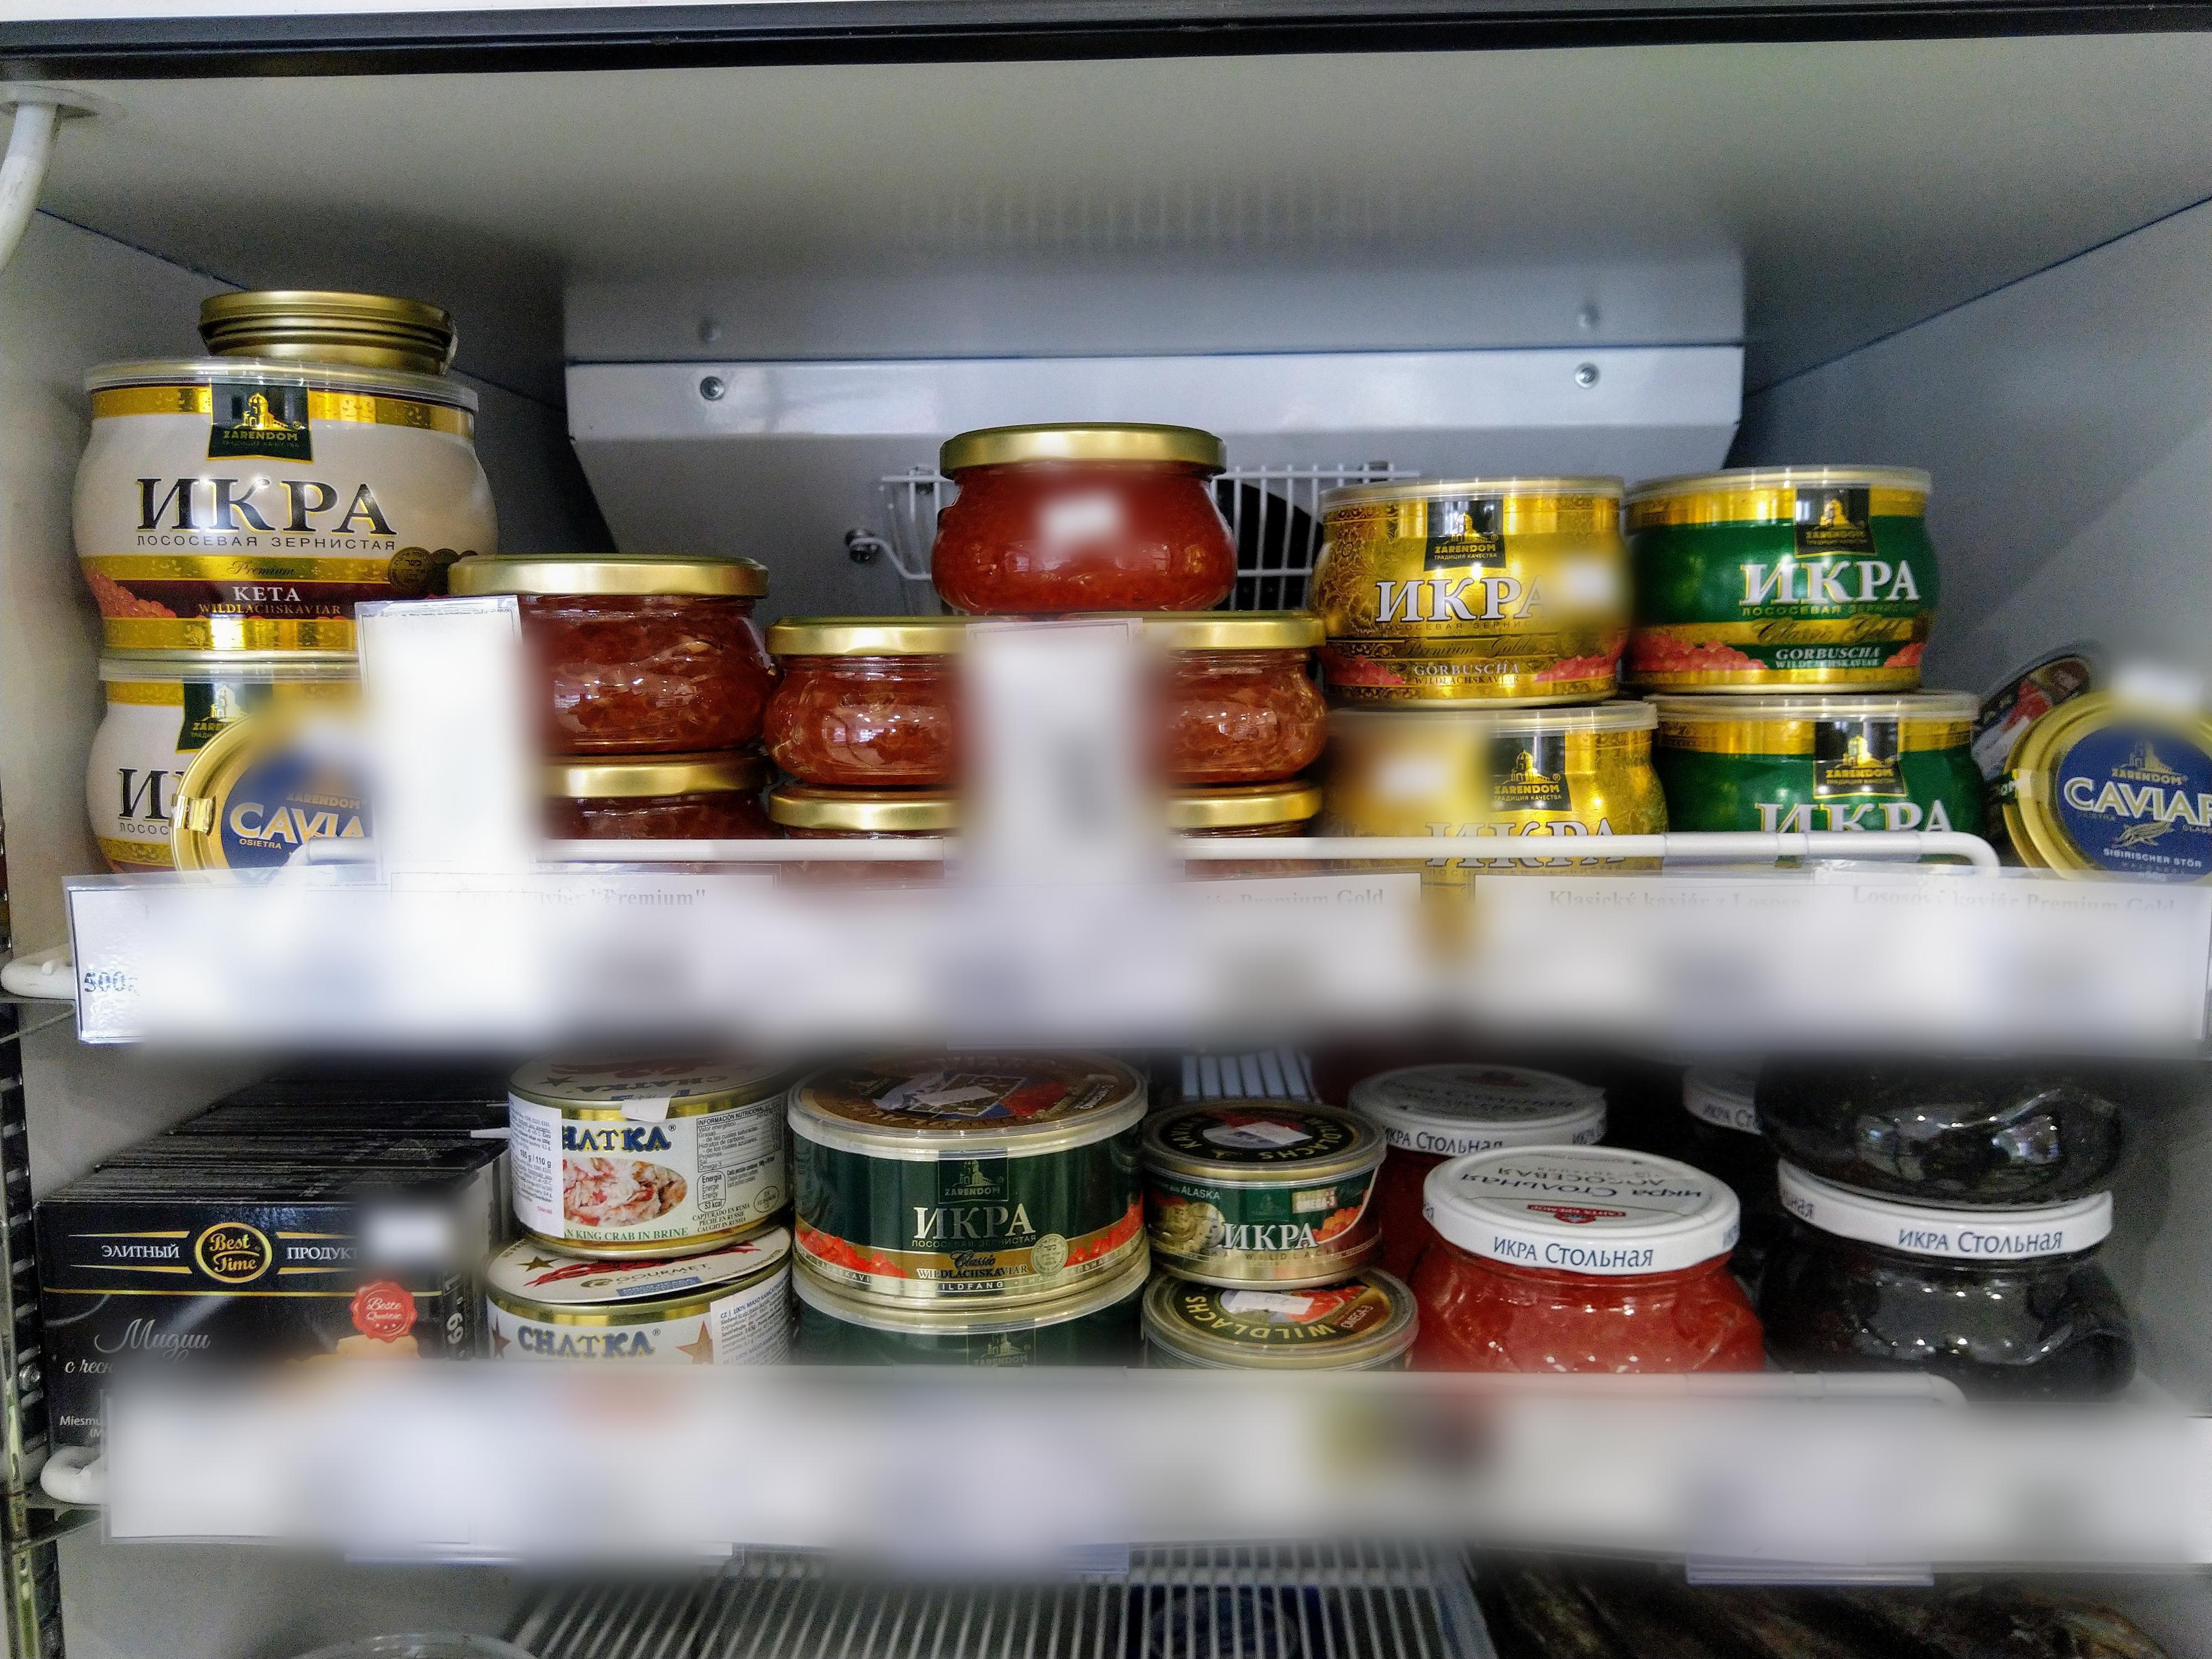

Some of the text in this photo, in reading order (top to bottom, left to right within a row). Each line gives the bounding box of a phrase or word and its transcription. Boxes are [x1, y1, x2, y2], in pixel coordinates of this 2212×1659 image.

[223, 430, 298, 441] ZARENDOM
[138, 478, 397, 536] ИКРА
[137, 535, 395, 551] ЛОСОСЕВАЯ ЗЕРНИСТАЯ
[1434, 544, 1496, 554] ZARENDOM
[227, 560, 295, 576] Premium
[1739, 560, 1921, 605] ИКРА
[1776, 646, 1880, 660] GORBUSCHA
[1414, 664, 1519, 676] GORBUSCHA
[1494, 785, 1559, 795] ZARENDOM
[239, 838, 281, 849] OSIETRA
[535, 1155, 545, 1165] 110
[1181, 1186, 1220, 1200] ALASKA
[692, 1210, 727, 1221] CAPTURADO
[913, 1203, 1036, 1240] ИКРА
[576, 1230, 601, 1240] KING
[605, 1232, 635, 1240] CRAB
[654, 1227, 688, 1239] BRINE
[697, 1224, 721, 1233] CAUGHT
[1222, 1222, 1318, 1251] ИКРА
[209, 1233, 250, 1253] Best
[1898, 1229, 1949, 1251] ИКРА
[101, 1242, 180, 1260] ЭЛИТНЫЙ
[1494, 1237, 1537, 1261] ИКРА
[212, 1254, 257, 1274] Time
[367, 1297, 402, 1311] Beste
[1184, 1295, 1337, 1339] WILDLACHS
[95, 1318, 211, 1363] Мидии
[518, 1326, 654, 1358] CHATKA
